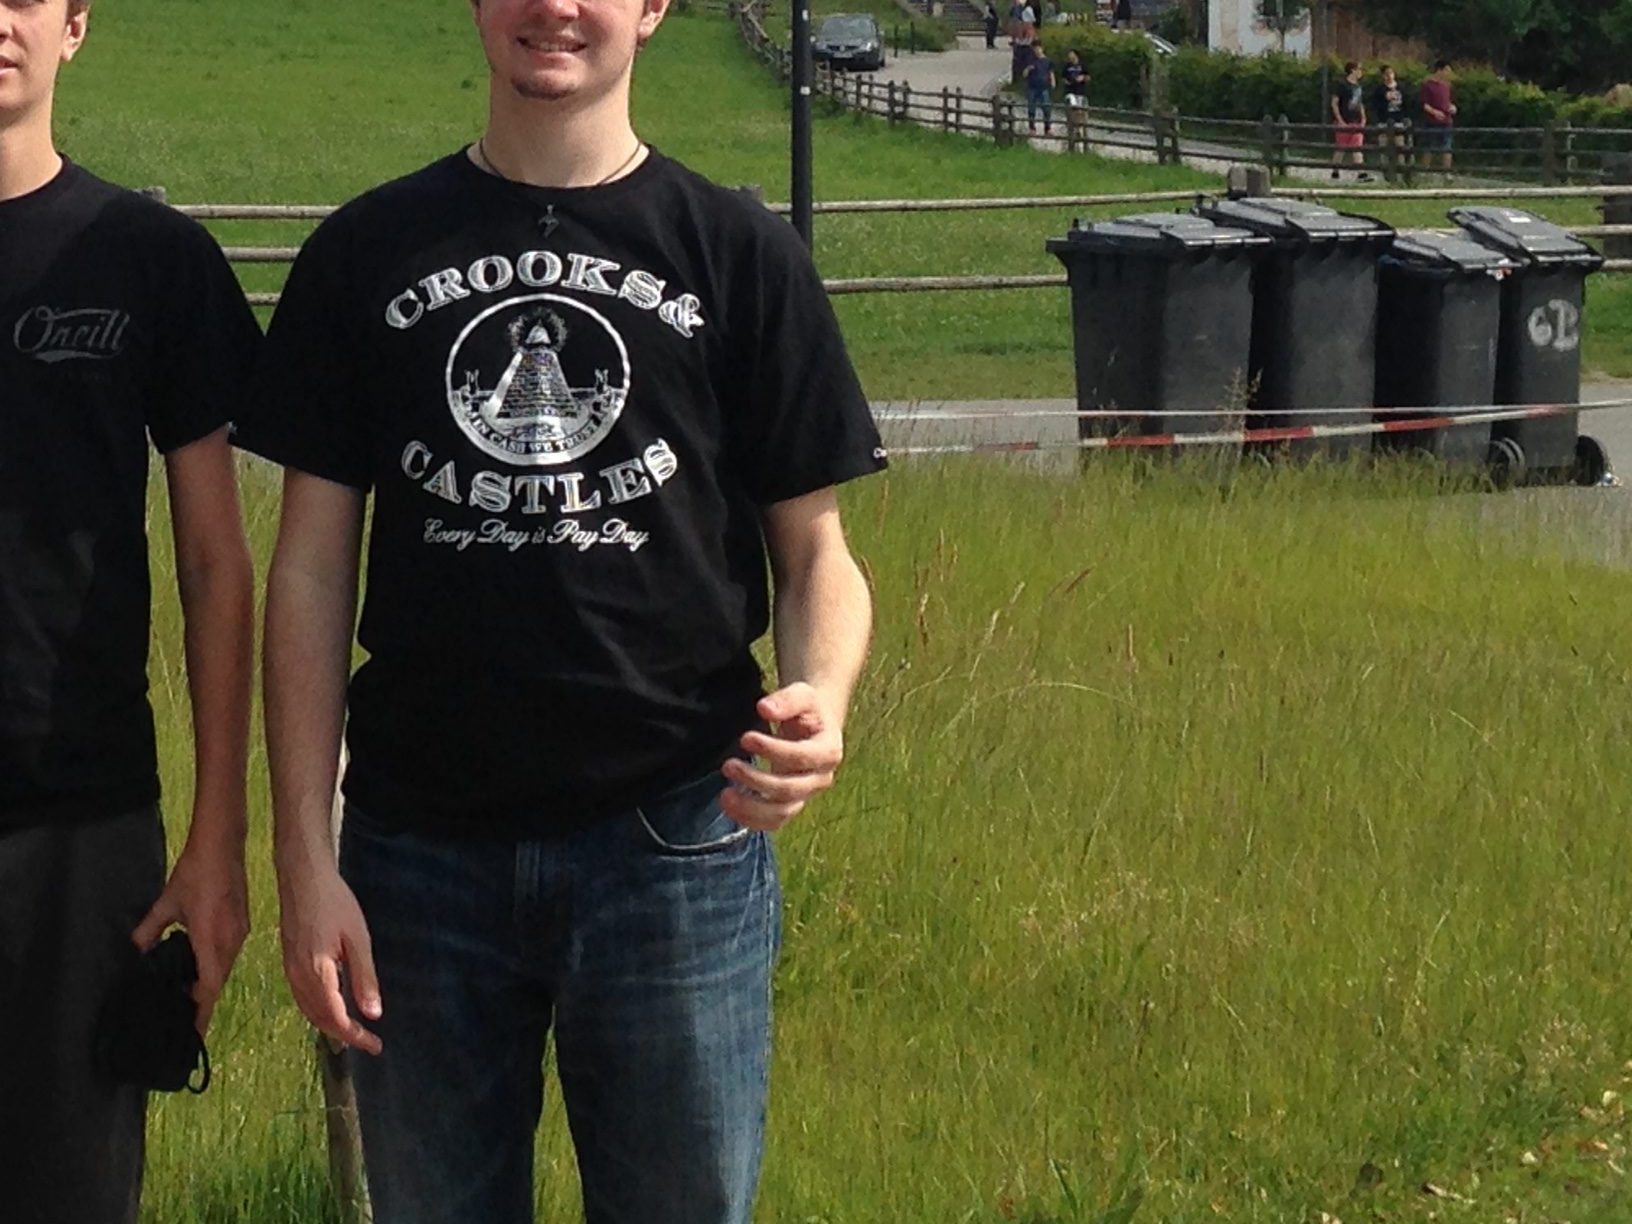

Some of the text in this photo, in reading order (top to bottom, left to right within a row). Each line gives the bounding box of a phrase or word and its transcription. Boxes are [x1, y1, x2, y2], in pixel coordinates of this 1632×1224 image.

[384, 250, 705, 338] CROOKS &
[400, 437, 678, 515] CASTLES
[423, 517, 650, 552] Every Day is Pay Day
